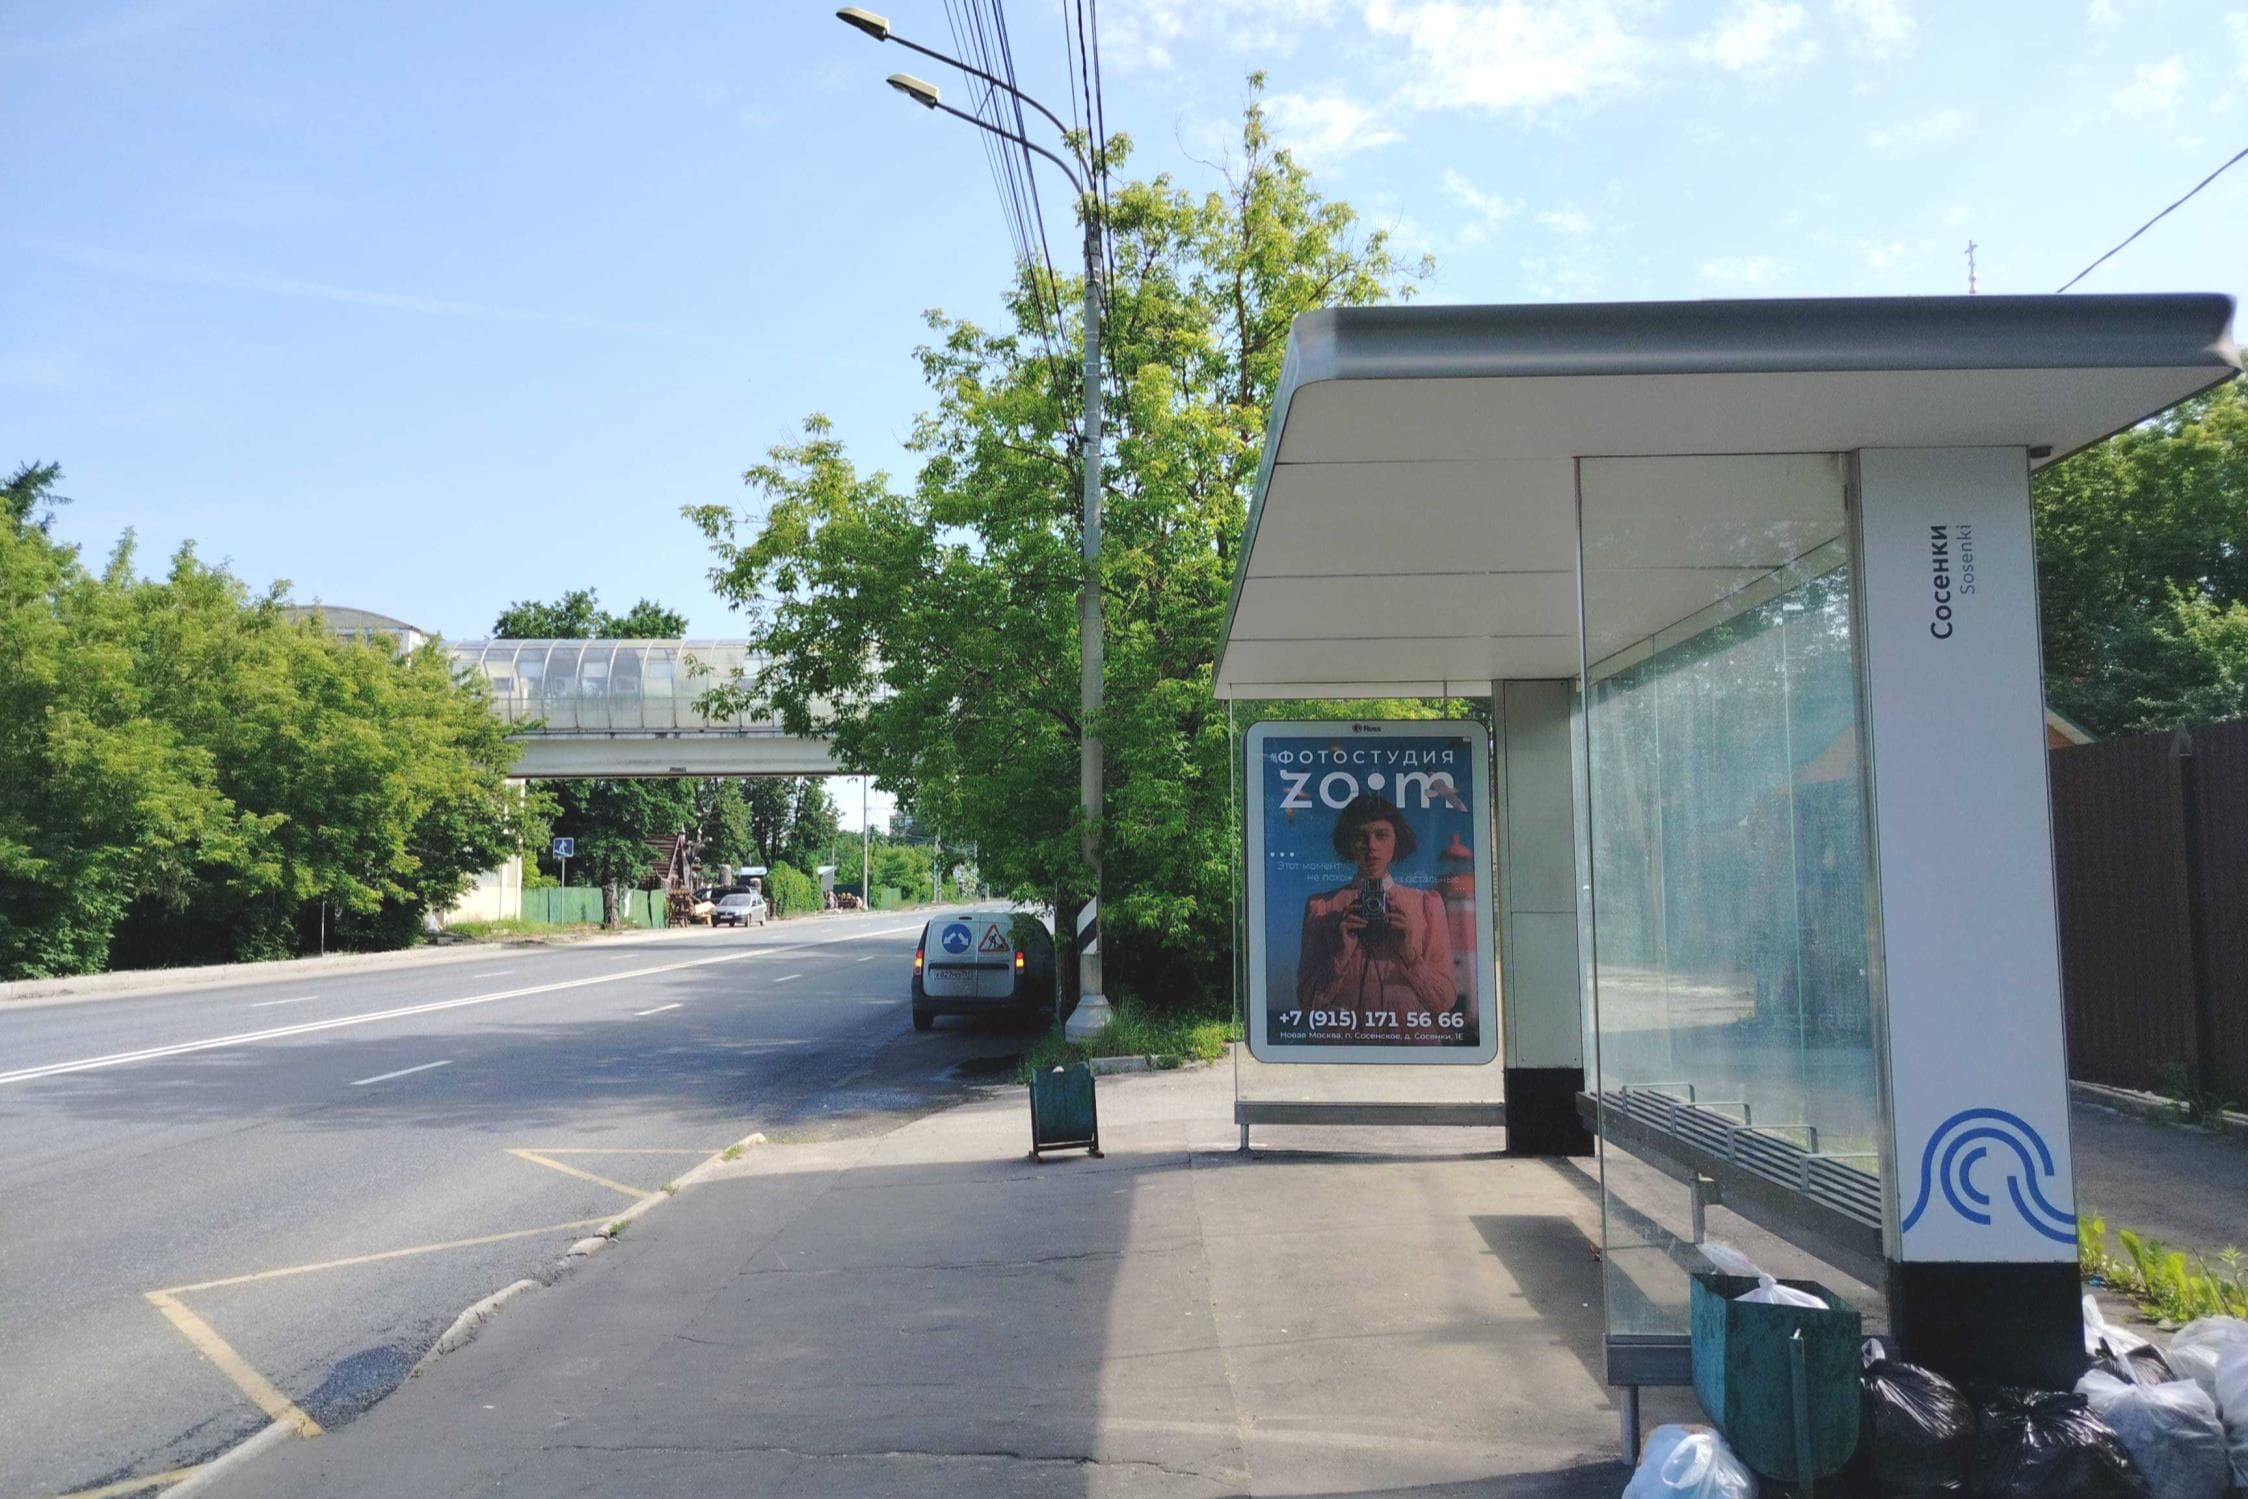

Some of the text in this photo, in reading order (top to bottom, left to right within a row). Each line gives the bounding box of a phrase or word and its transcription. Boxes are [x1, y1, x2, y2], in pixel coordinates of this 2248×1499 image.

[1956, 525, 1975, 594] Sosenki
[1930, 525, 1953, 639] Сосенки
[1278, 750, 1454, 766] ФОТОСТУДИЯ
[1277, 861, 1342, 871] Этот момент
[1280, 1010, 1464, 1030] +7 (915) 171 56 66
[1309, 1032, 1343, 1040] Москва,
[1355, 1032, 1402, 1040] Сосенское,
[1414, 1033, 1453, 1041] Сосенки,
